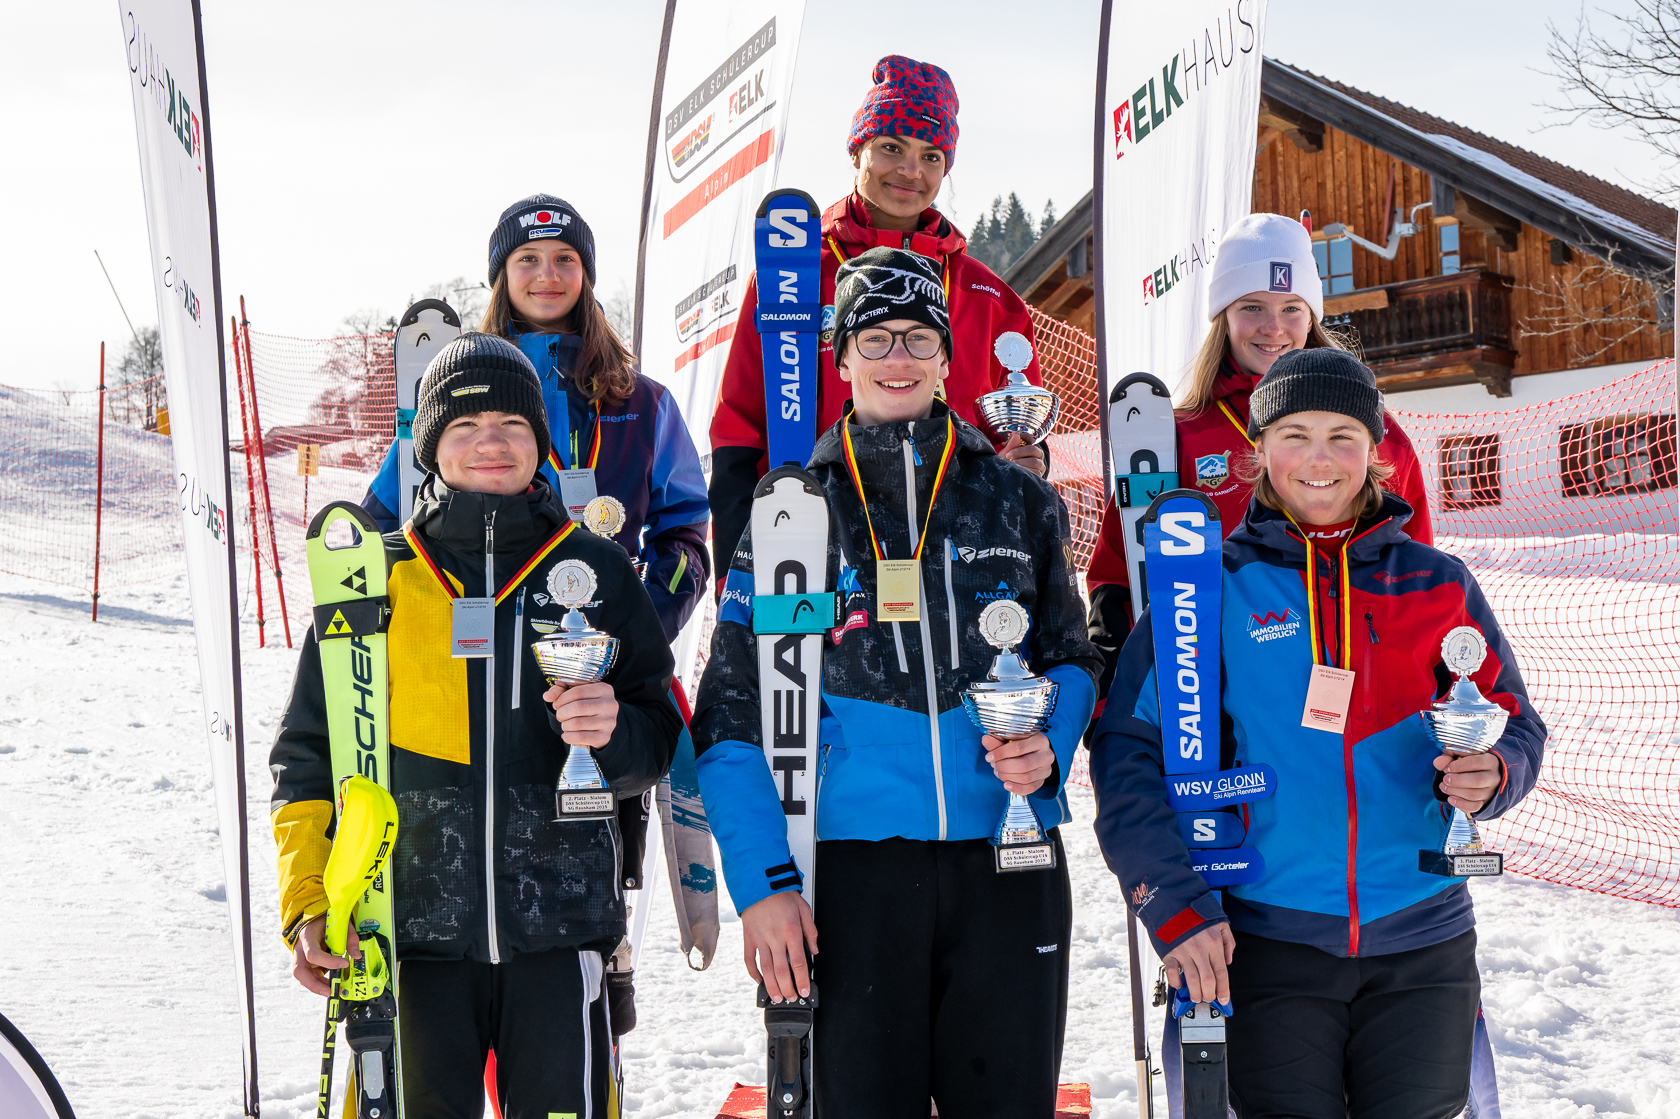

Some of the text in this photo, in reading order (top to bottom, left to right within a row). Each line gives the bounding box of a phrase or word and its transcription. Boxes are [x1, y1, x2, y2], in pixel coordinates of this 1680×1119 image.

[738, 68, 765, 116] ELK
[667, 107, 685, 135] DSV
[689, 88, 705, 114] ELK
[704, 172, 729, 200] Alpin
[519, 210, 571, 228] WOLF
[769, 209, 808, 248] S
[1275, 268, 1286, 285] K
[760, 313, 811, 321] SALOMON
[599, 413, 640, 423] ziener
[1160, 511, 1205, 556] S
[976, 547, 1032, 563] ziener
[1391, 570, 1434, 584] ziener
[1250, 621, 1301, 639] IMMOBILIEN
[1256, 629, 1297, 644] WEIDLICH
[1174, 581, 1203, 761] SALOMON
[1174, 771, 1265, 796] WSV GLONN
[1223, 790, 1237, 799] Alpin
[1237, 786, 1266, 796] Rennteam
[1193, 818, 1216, 841] S
[364, 821, 395, 880] LEKI
[1211, 861, 1249, 871] Gürteler
[326, 977, 342, 1048] LEKI
